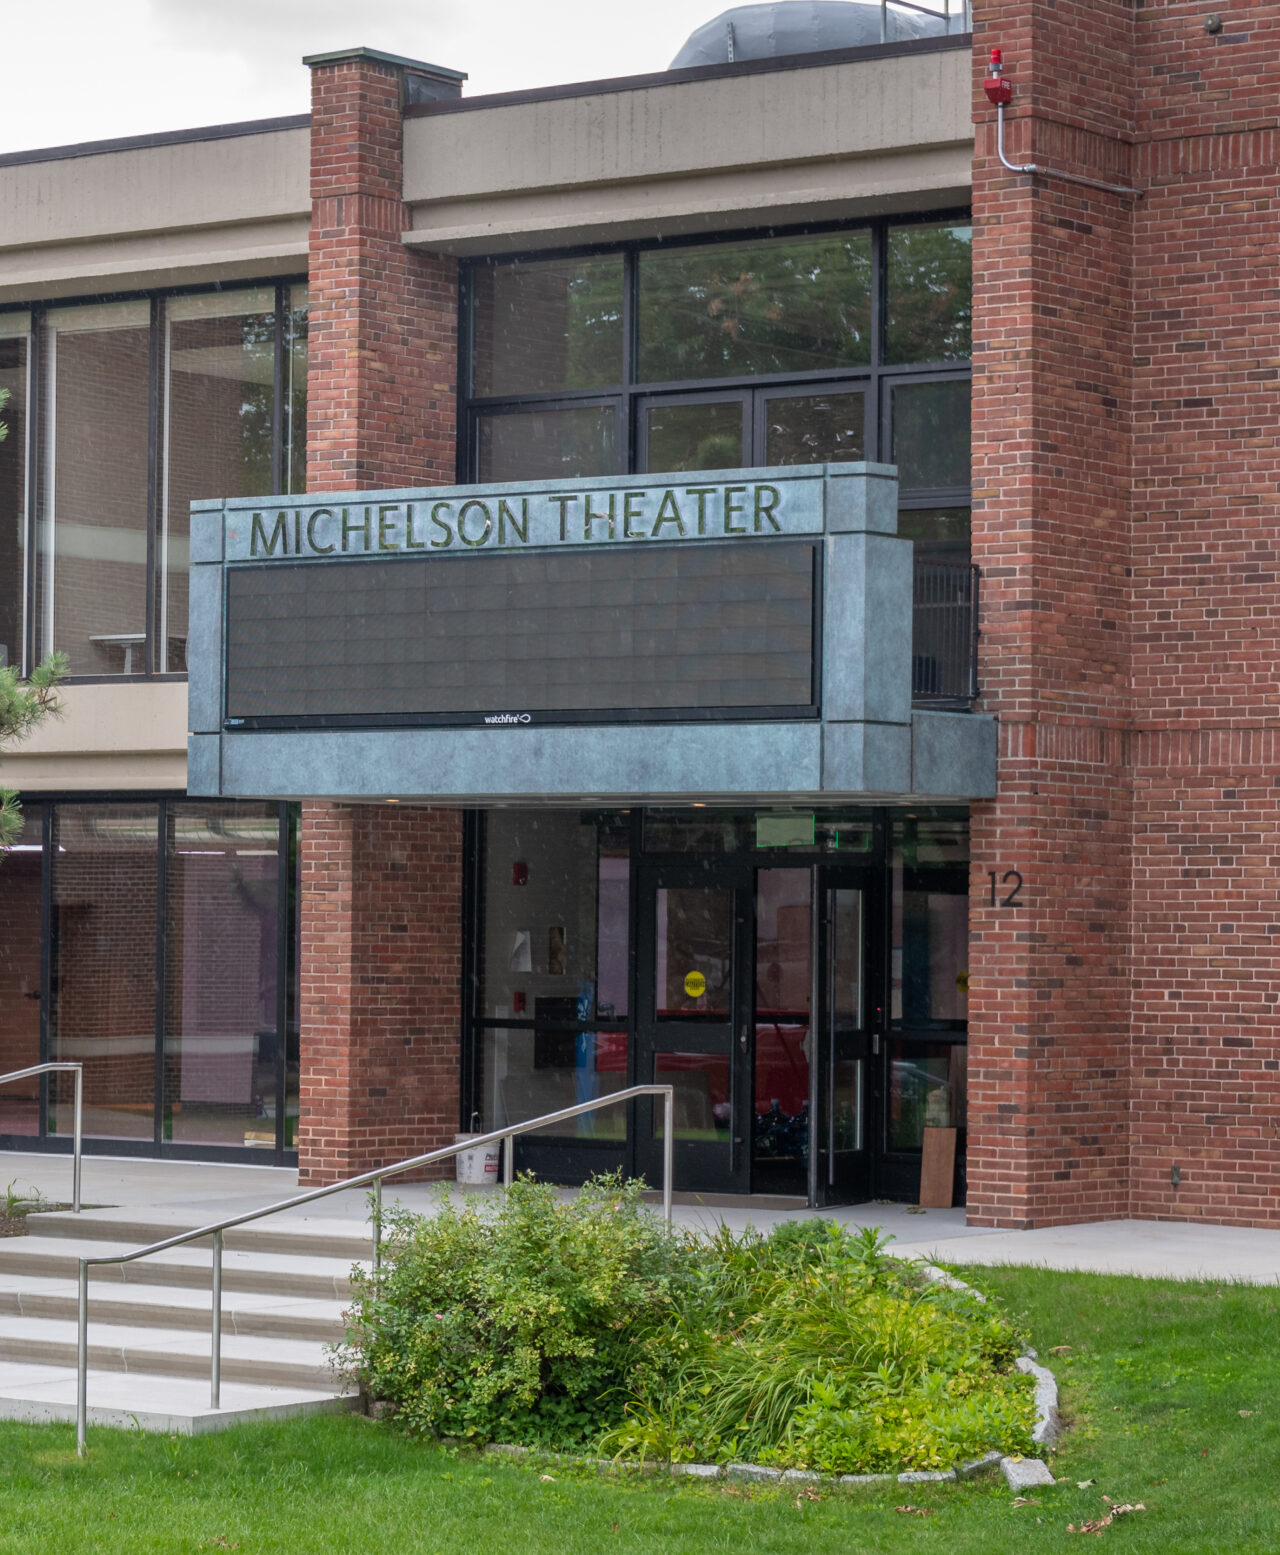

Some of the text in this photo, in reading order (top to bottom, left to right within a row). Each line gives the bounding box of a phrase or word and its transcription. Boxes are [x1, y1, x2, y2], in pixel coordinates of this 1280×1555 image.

[250, 485, 781, 556] MICHELSON THEATER
[484, 714, 518, 724] watchfire
[988, 870, 1023, 907] 12
